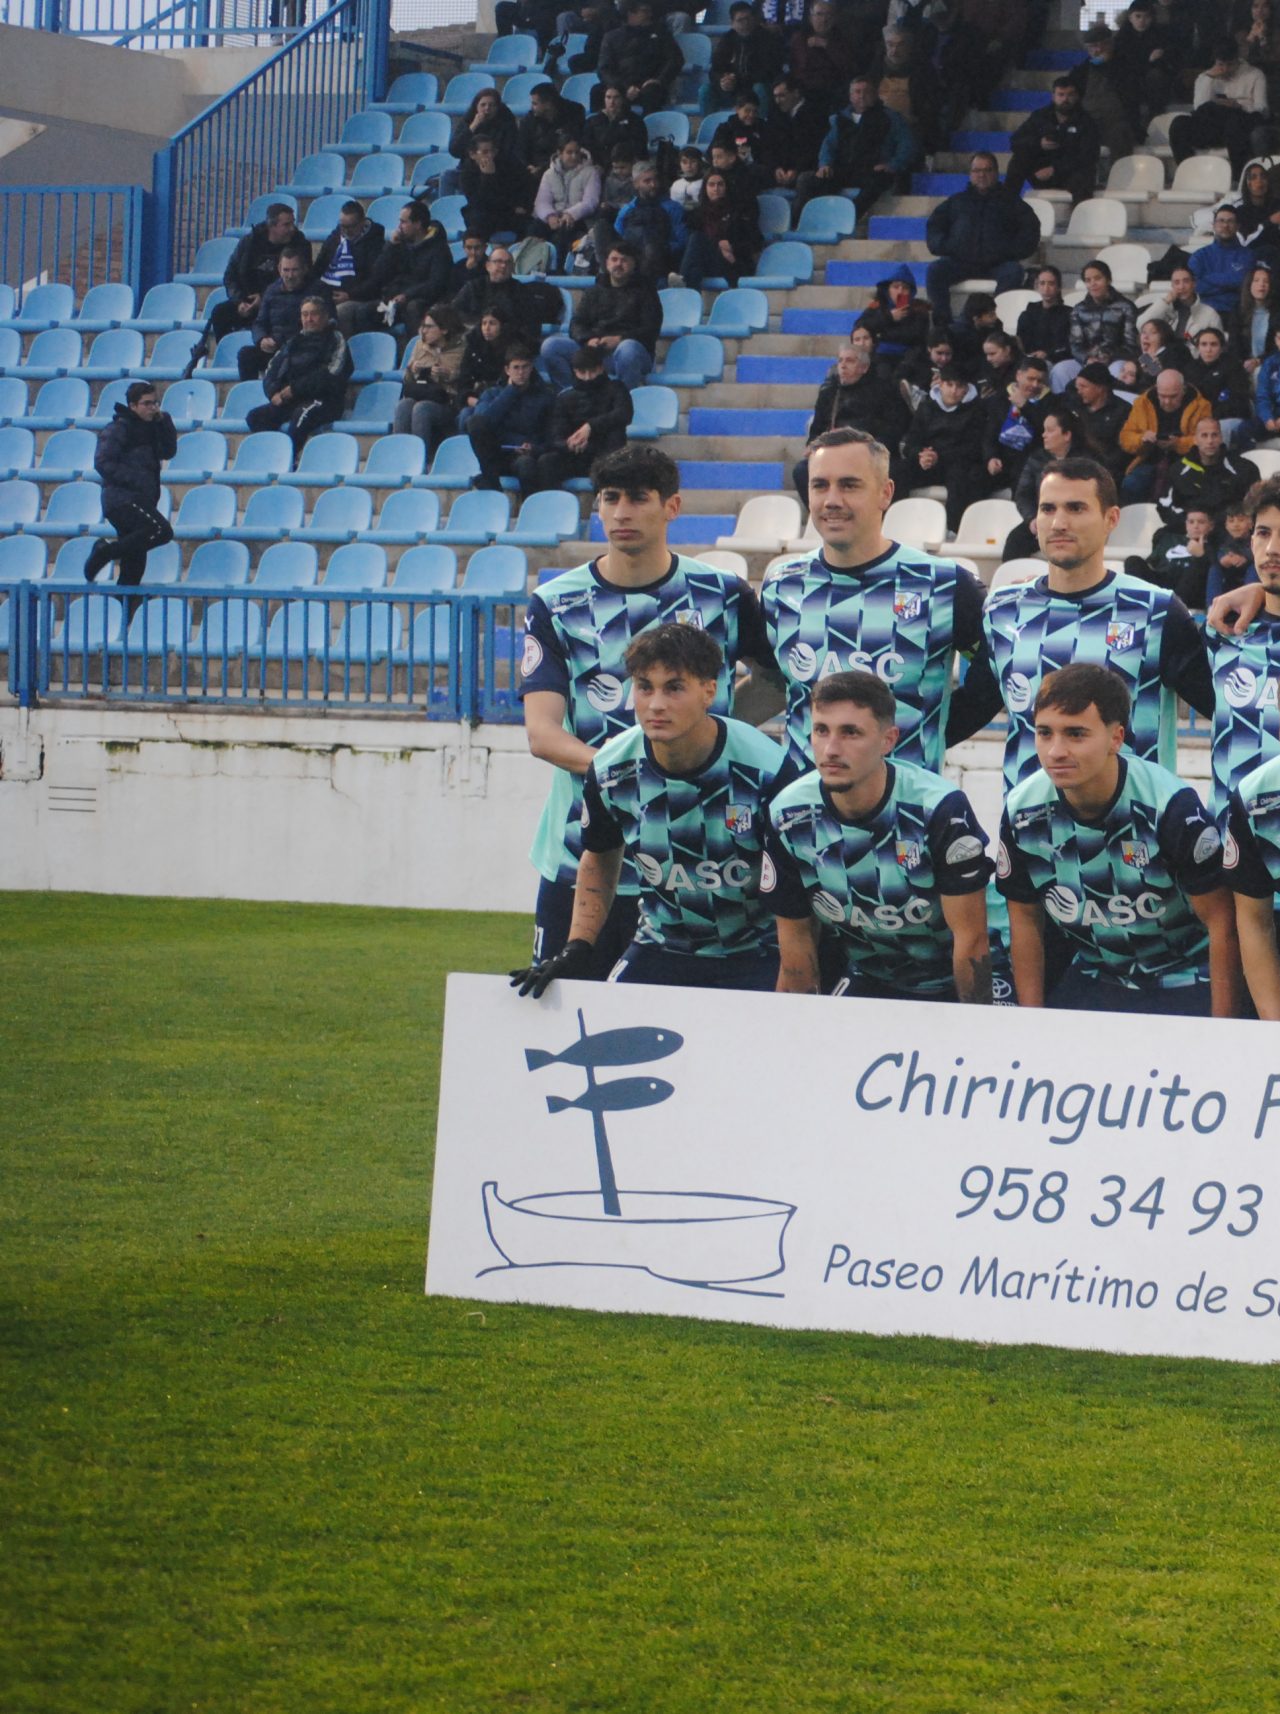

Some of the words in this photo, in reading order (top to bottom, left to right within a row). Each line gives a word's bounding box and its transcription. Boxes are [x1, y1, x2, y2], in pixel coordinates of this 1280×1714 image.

[665, 859, 752, 891] ASC
[850, 898, 933, 931] ASC
[1081, 892, 1167, 928] ASC
[856, 1050, 1226, 1145] Chiringuito
[956, 1165, 1068, 1224] 958
[1091, 1175, 1165, 1230] 34
[1188, 1181, 1263, 1237] 93
[824, 1244, 943, 1292] Paseo
[960, 1256, 1158, 1308] Marítimo
[1176, 1271, 1227, 1313] de
